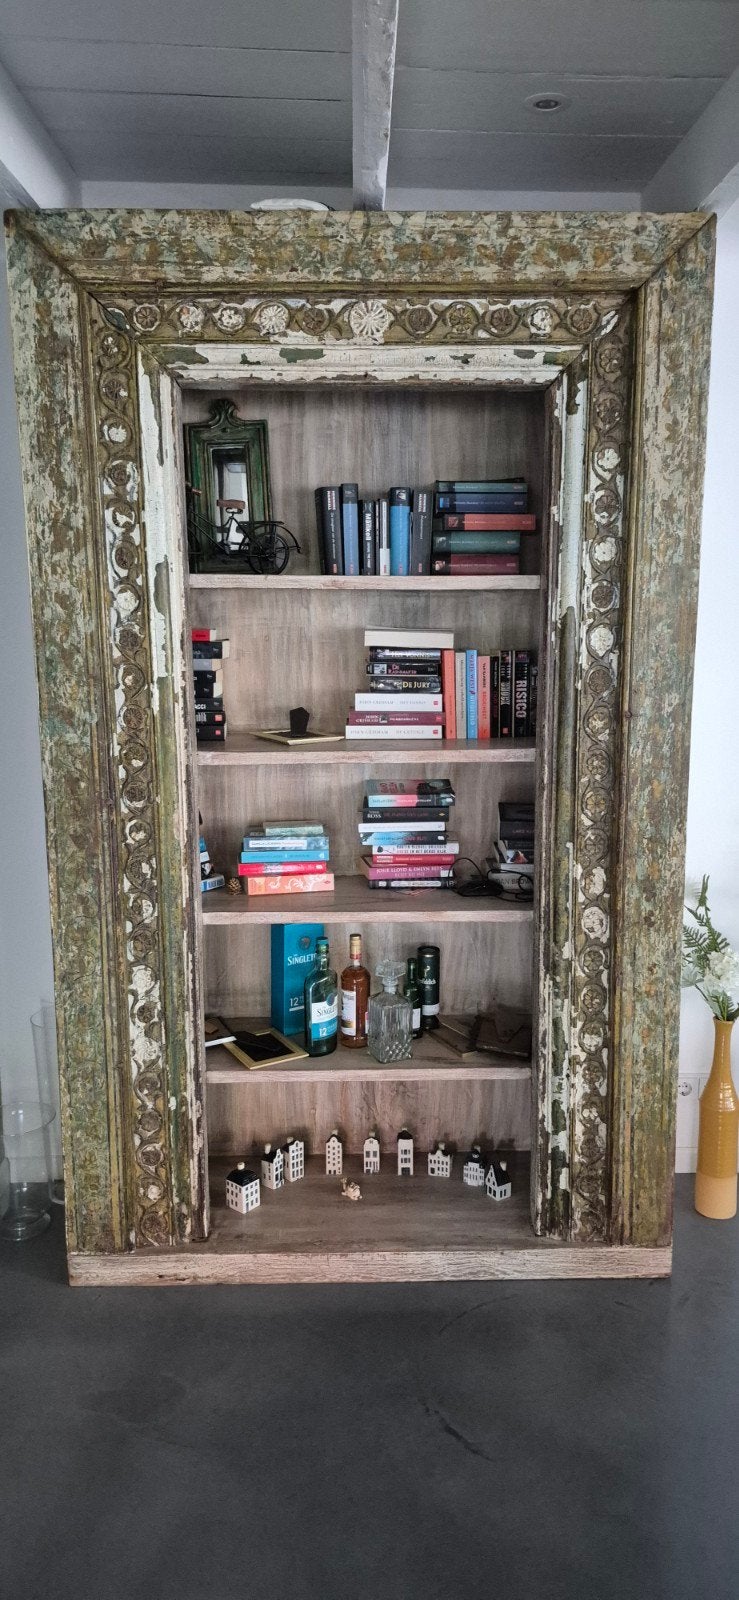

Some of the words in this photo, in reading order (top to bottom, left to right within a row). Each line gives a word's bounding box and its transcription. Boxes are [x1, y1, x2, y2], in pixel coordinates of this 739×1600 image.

[413, 681, 430, 689] JURY
[515, 680, 527, 718] RISICO
[290, 997, 300, 1007] 12
[319, 1027, 328, 1037] 12
